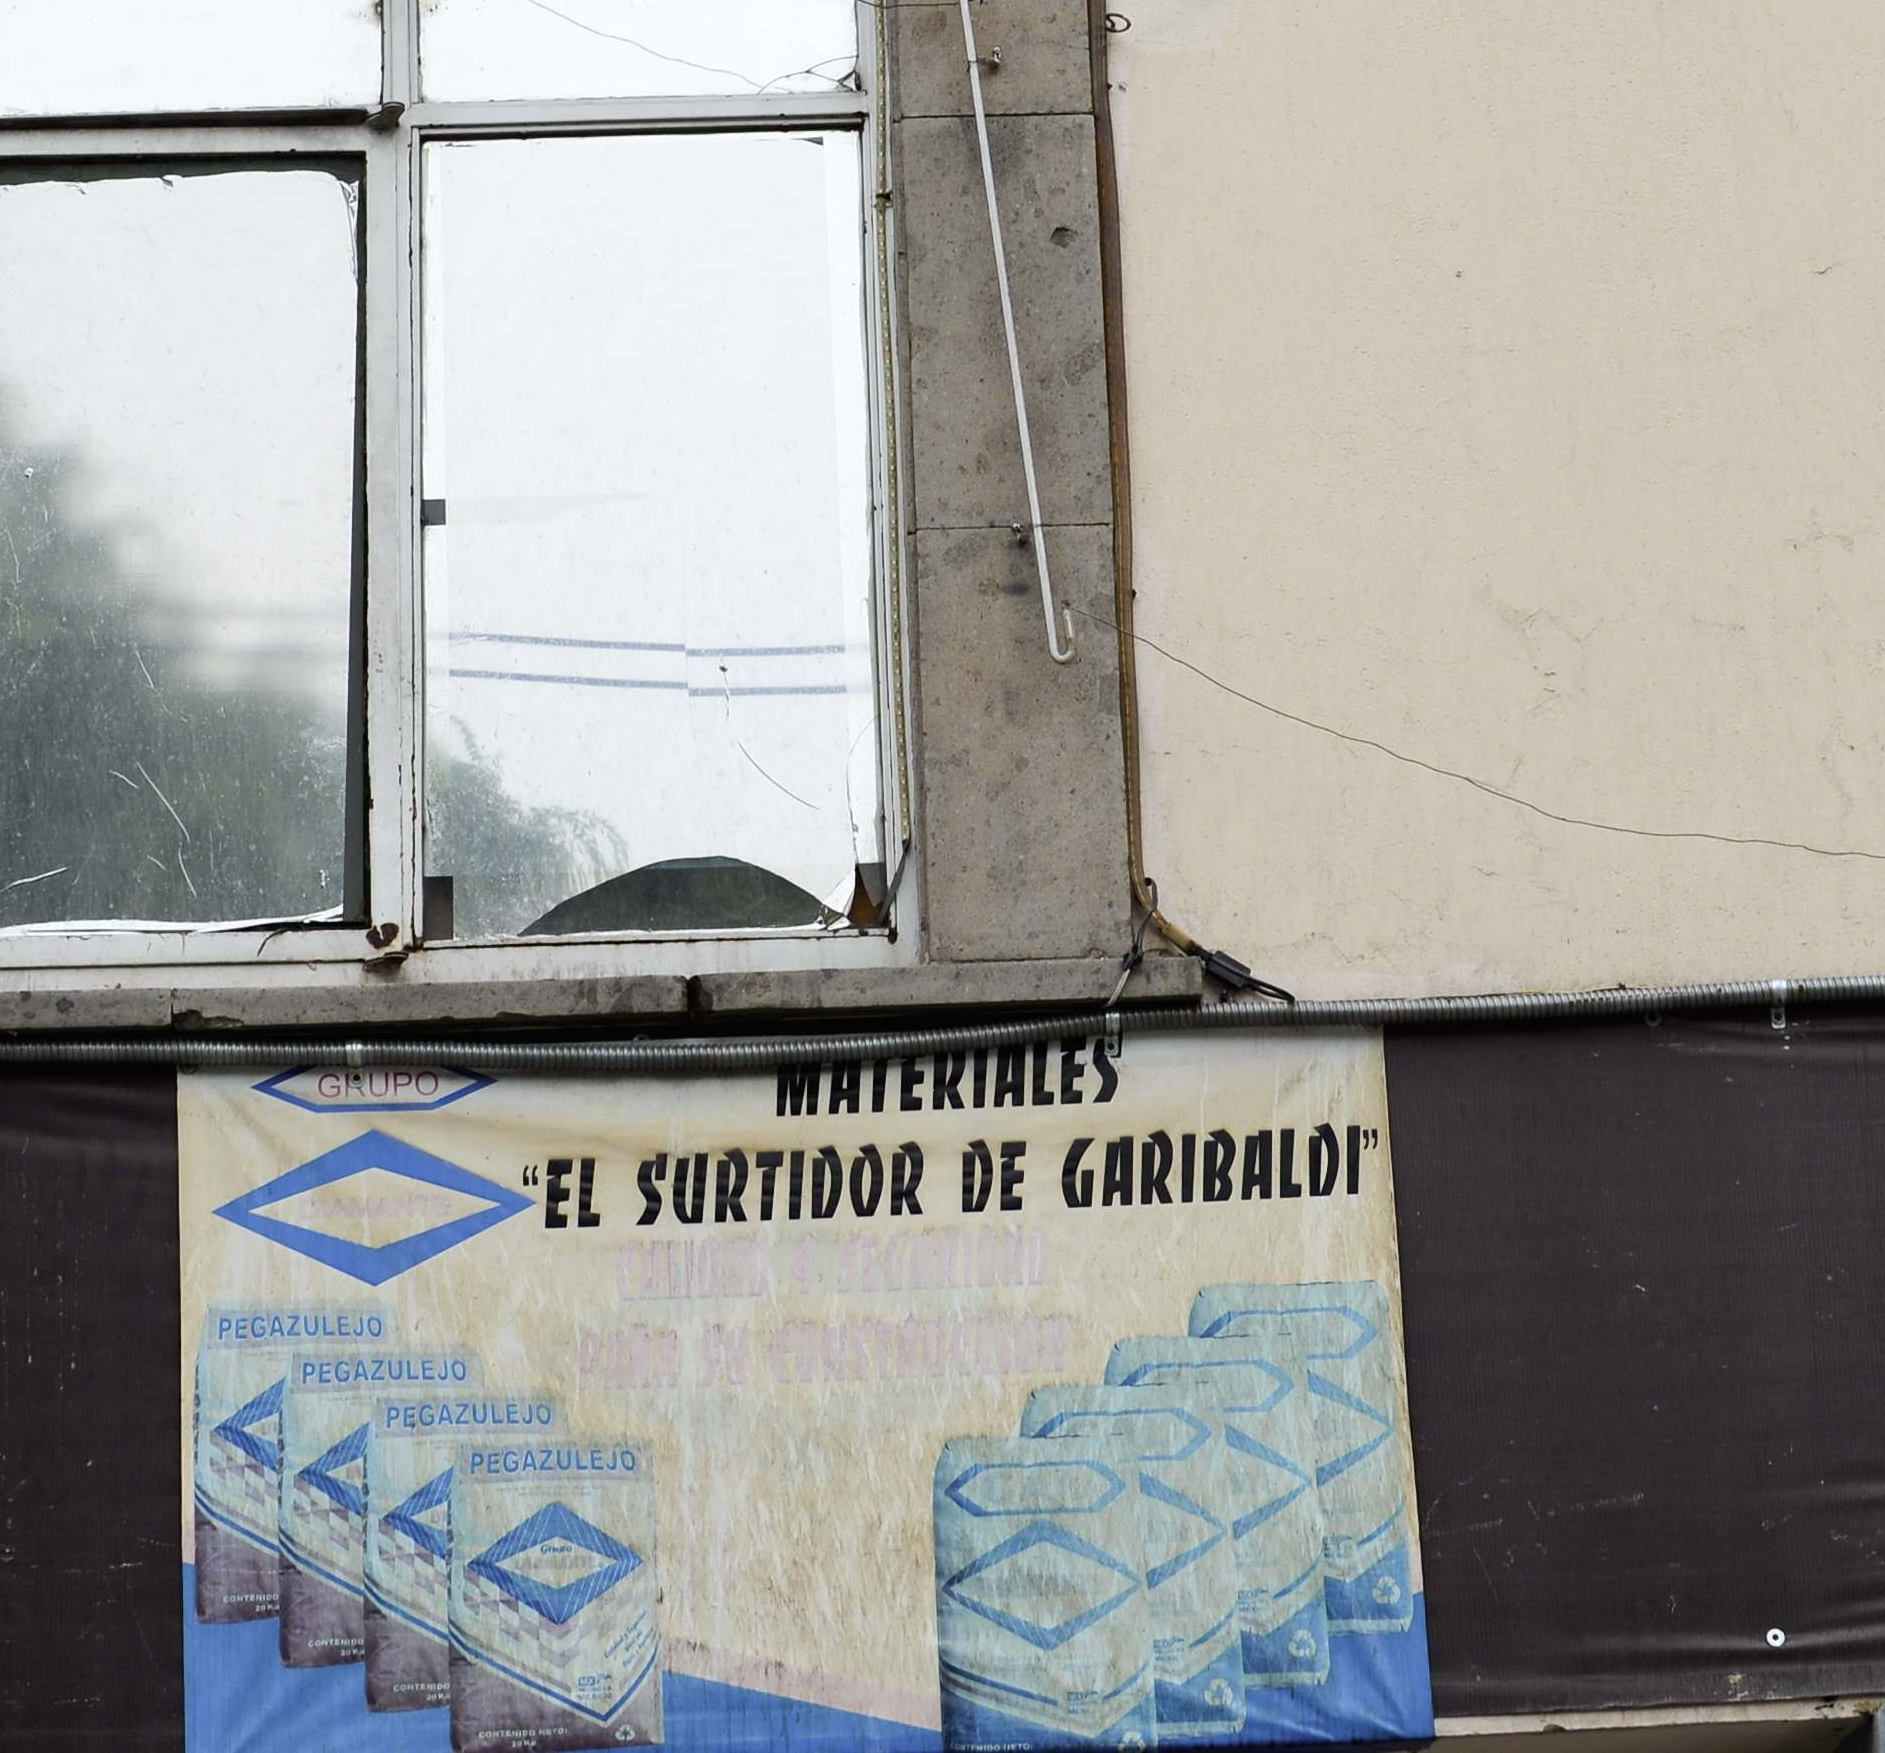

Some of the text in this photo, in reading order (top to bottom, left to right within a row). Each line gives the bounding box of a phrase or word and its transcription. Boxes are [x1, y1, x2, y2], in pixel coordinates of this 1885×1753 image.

[317, 1070, 440, 1098] GRUPO
[775, 1037, 1119, 1116] MATERIALES
[636, 1140, 926, 1226] SURTIDOR
[962, 1139, 1029, 1213] DE
[218, 1315, 383, 1340] PEGAZULEJO
[301, 1359, 467, 1385] PEGAZULEJO
[386, 1403, 552, 1428] PEGAZULEJO
[470, 1449, 636, 1474] PEGAZULEJO
